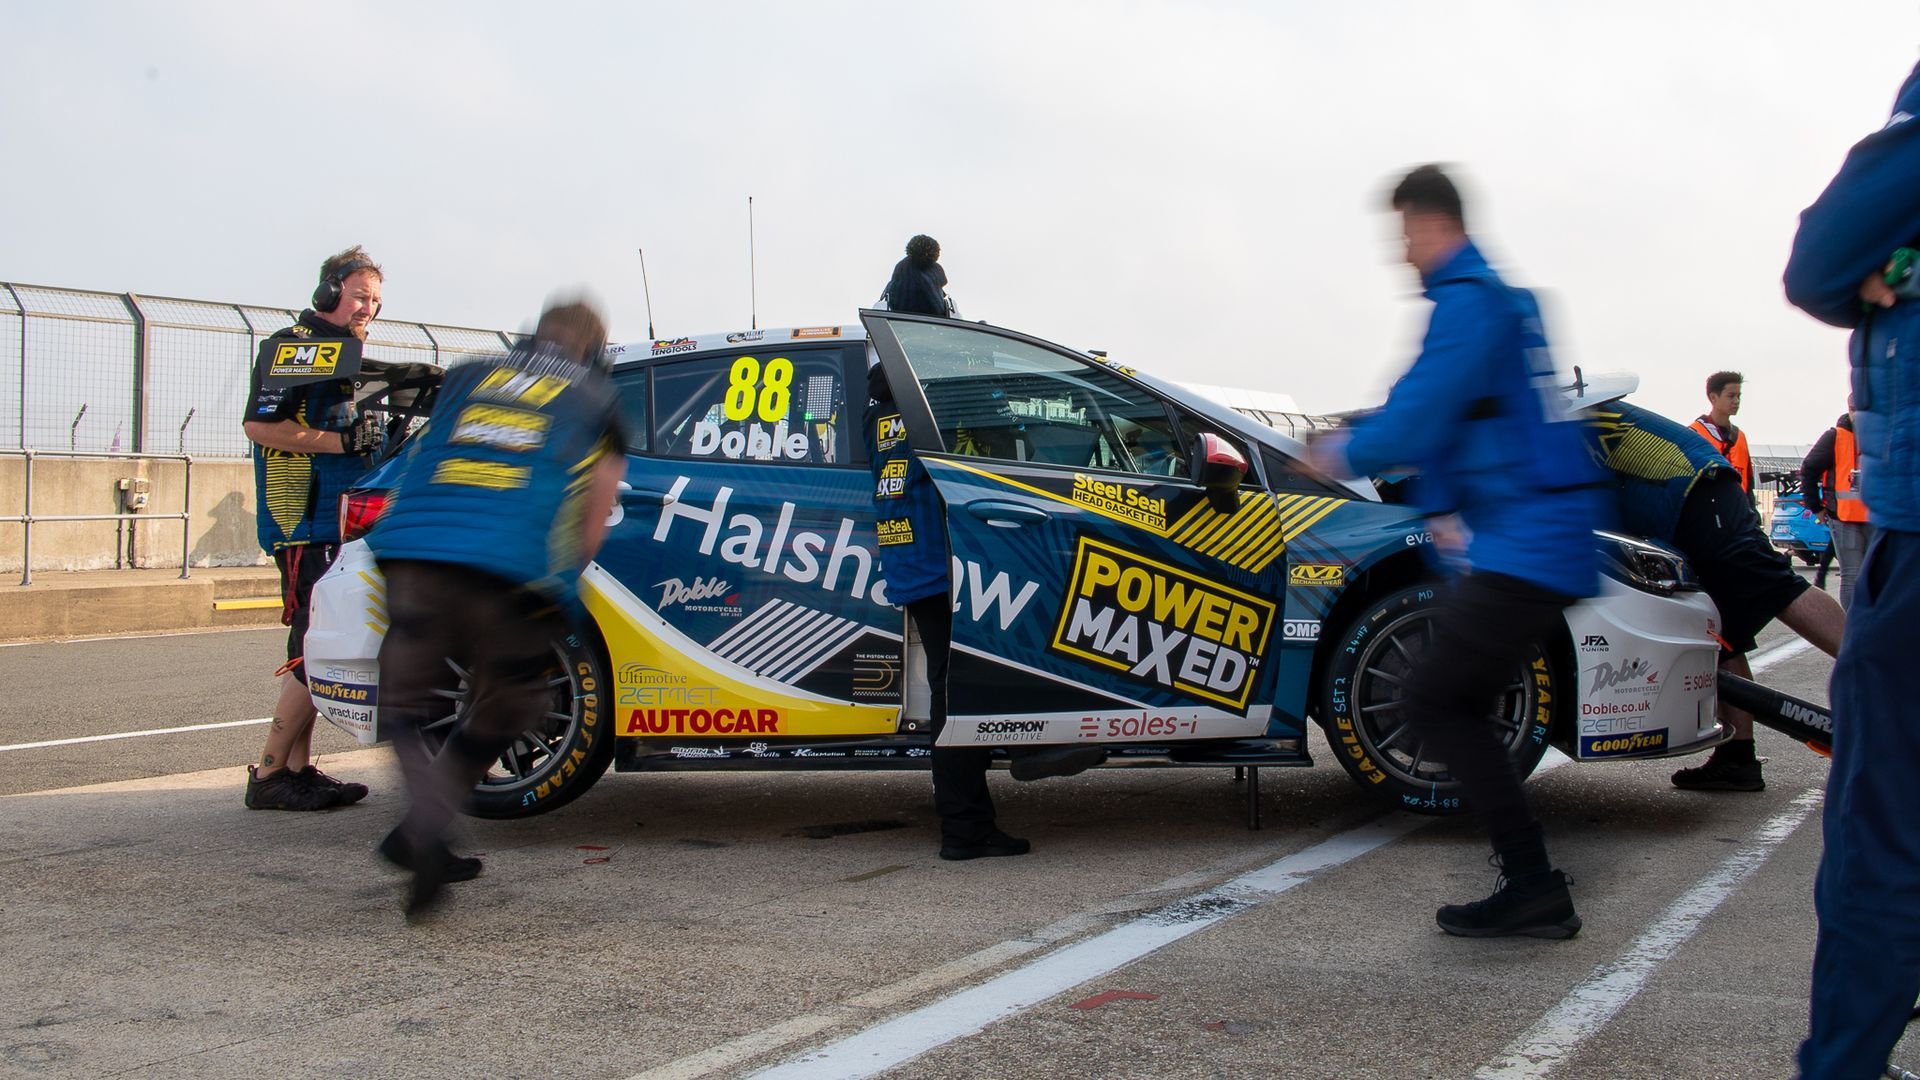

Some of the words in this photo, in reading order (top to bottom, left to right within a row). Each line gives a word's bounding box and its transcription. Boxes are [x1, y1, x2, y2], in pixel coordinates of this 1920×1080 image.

[277, 346, 337, 365] PMR
[724, 356, 794, 423] 88
[691, 421, 809, 460] Doble
[1073, 472, 1123, 502] Steel
[1125, 487, 1166, 517] Seal
[1074, 490, 1104, 507] HEAD
[1105, 501, 1146, 522] GASKET
[1148, 514, 1165, 528] FIX
[890, 518, 912, 534] Seal
[1405, 531, 1436, 546] eva
[651, 576, 733, 613] Doble
[1080, 551, 1259, 652] POWER
[685, 605, 743, 613] MOTORCYCLES
[1283, 623, 1321, 638] OMP
[1066, 597, 1247, 693] MAXED
[1580, 635, 1609, 646] JFA
[617, 671, 688, 684] Ultimotive
[327, 706, 373, 722] practical
[1582, 700, 1651, 715] Doble.co.uk
[1780, 700, 1833, 734] WOR
[626, 708, 779, 734] AUTOCAR
[976, 721, 1045, 734] SCORPION
[1106, 712, 1198, 738] sales-i
[974, 733, 1042, 742] AUTOMOTIVE
[1590, 733, 1664, 752] GOODYEAR
[1336, 716, 1387, 785] EAGLE
